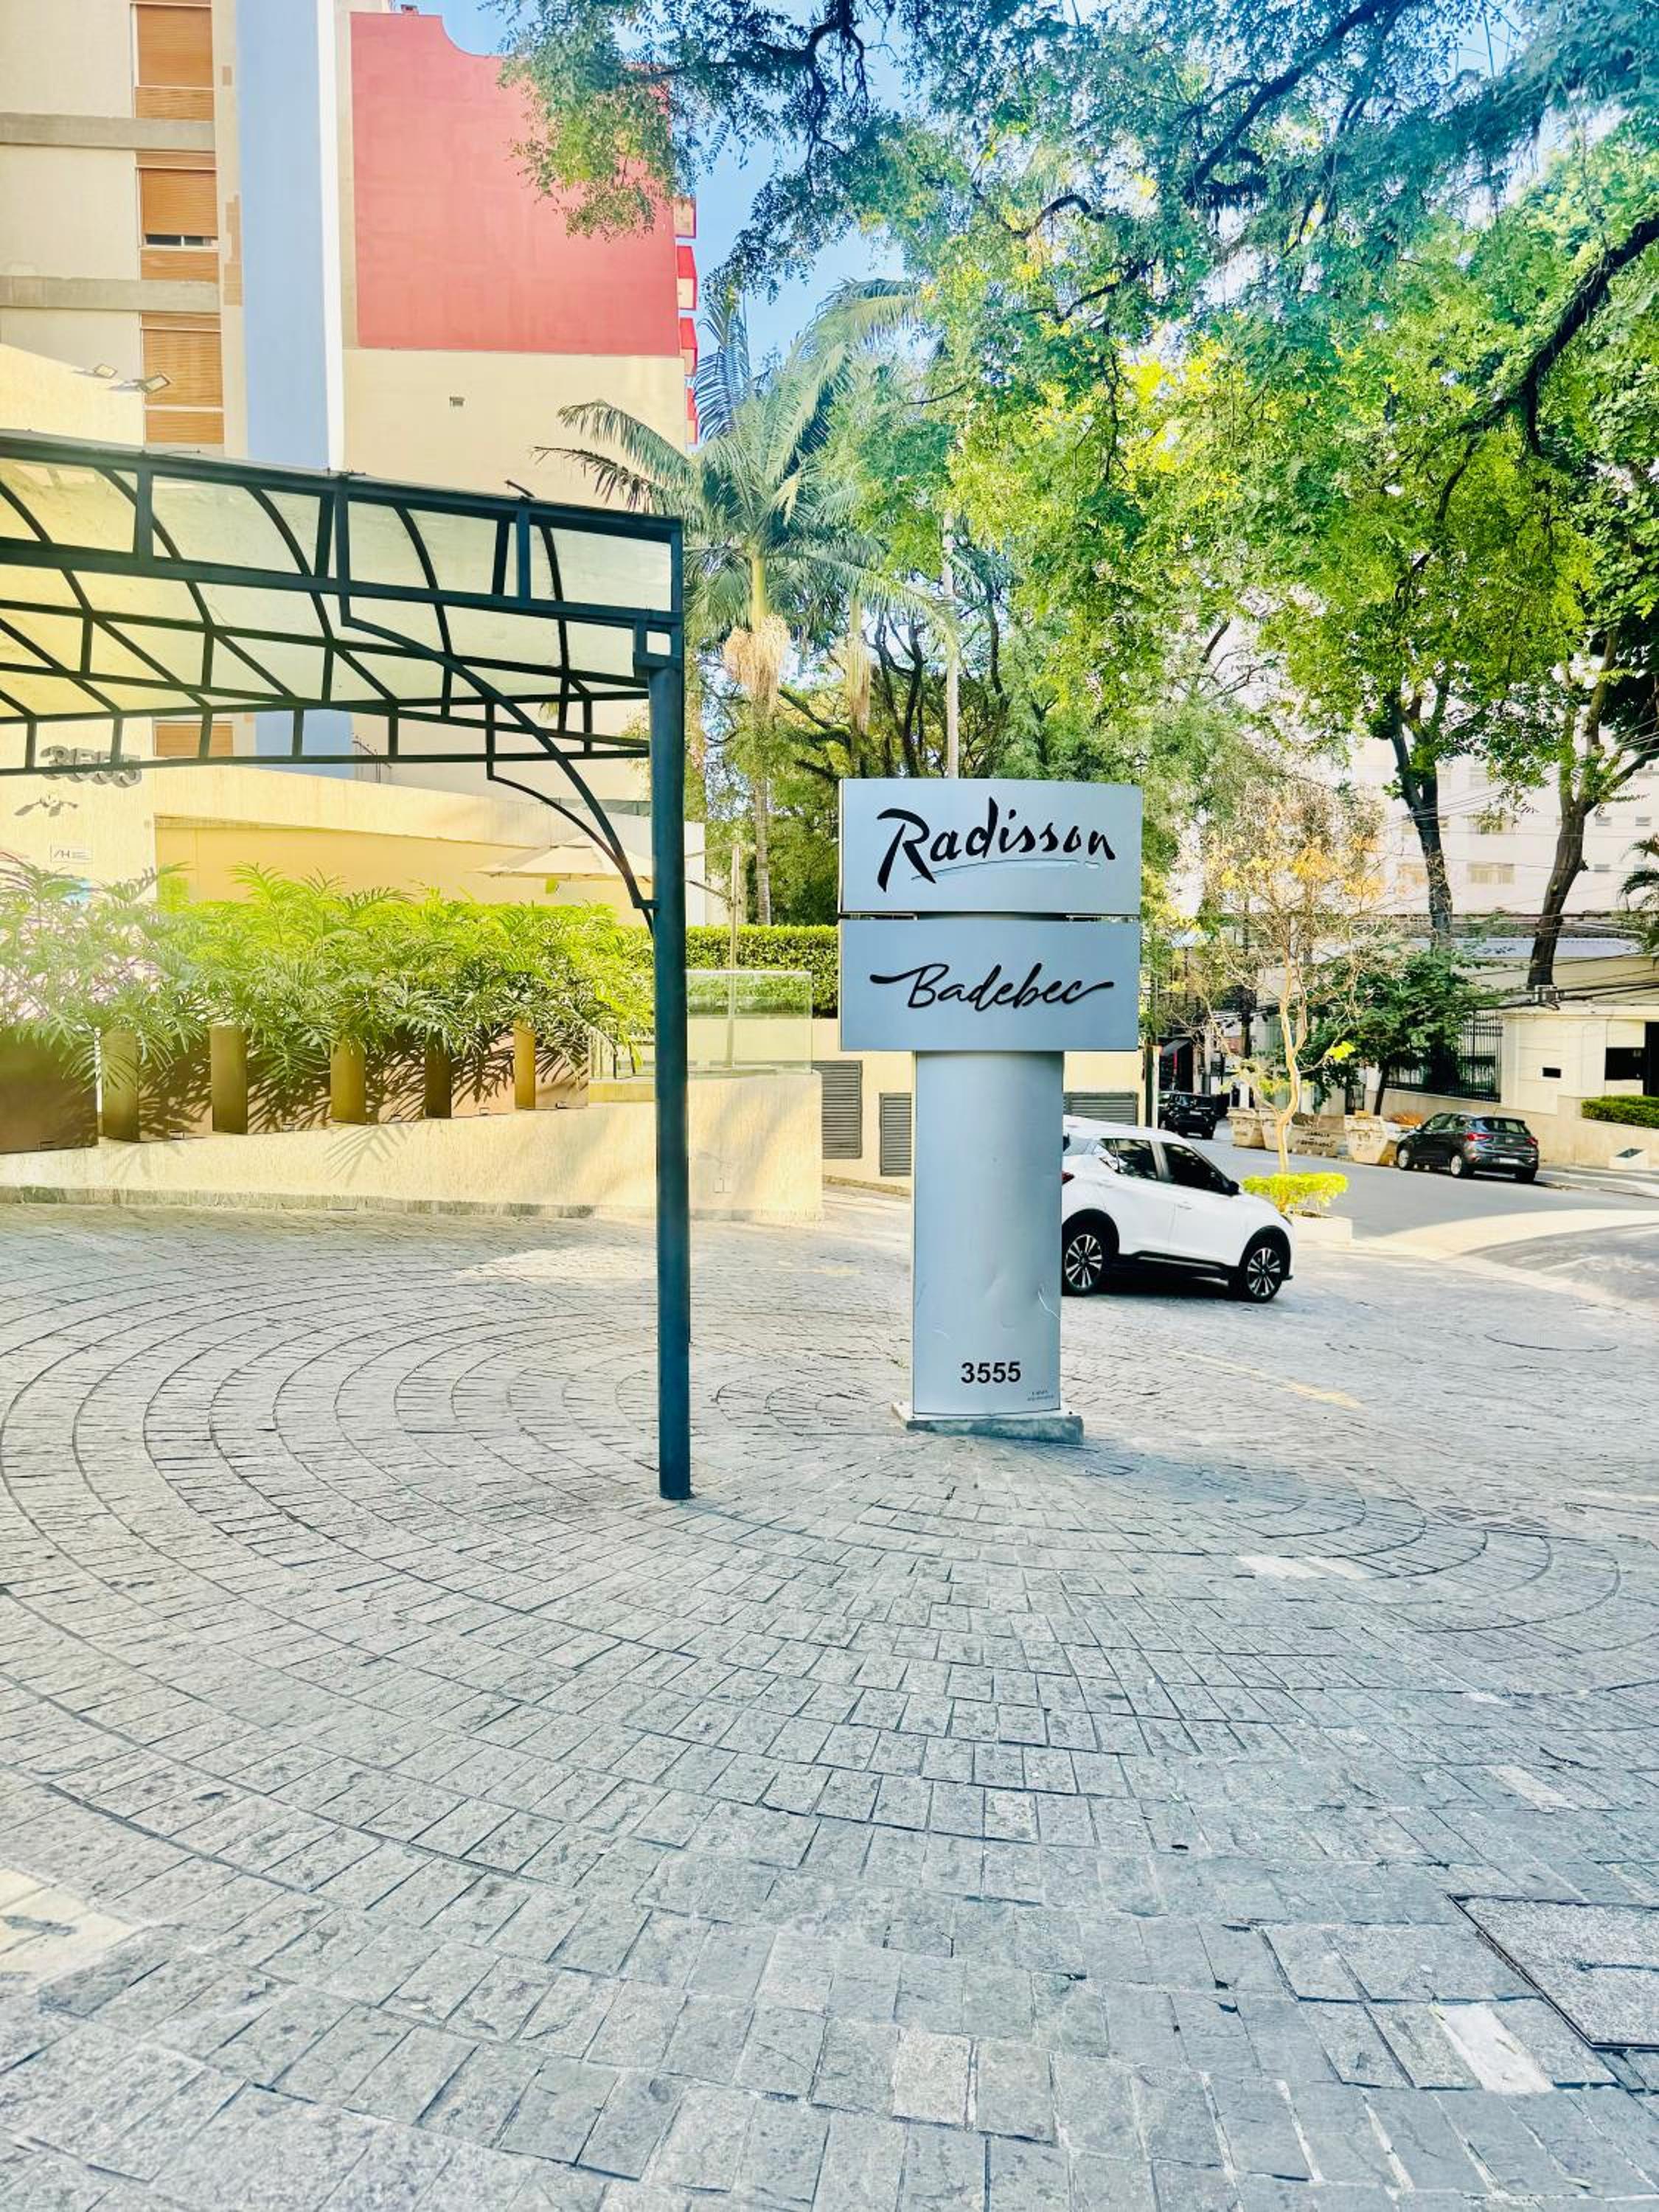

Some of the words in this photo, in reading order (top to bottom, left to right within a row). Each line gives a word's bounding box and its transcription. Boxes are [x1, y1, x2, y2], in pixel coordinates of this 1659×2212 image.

[877, 797, 1116, 893] Radisson
[869, 962, 1115, 1012] Badebec
[961, 1362, 1021, 1384] 3555
